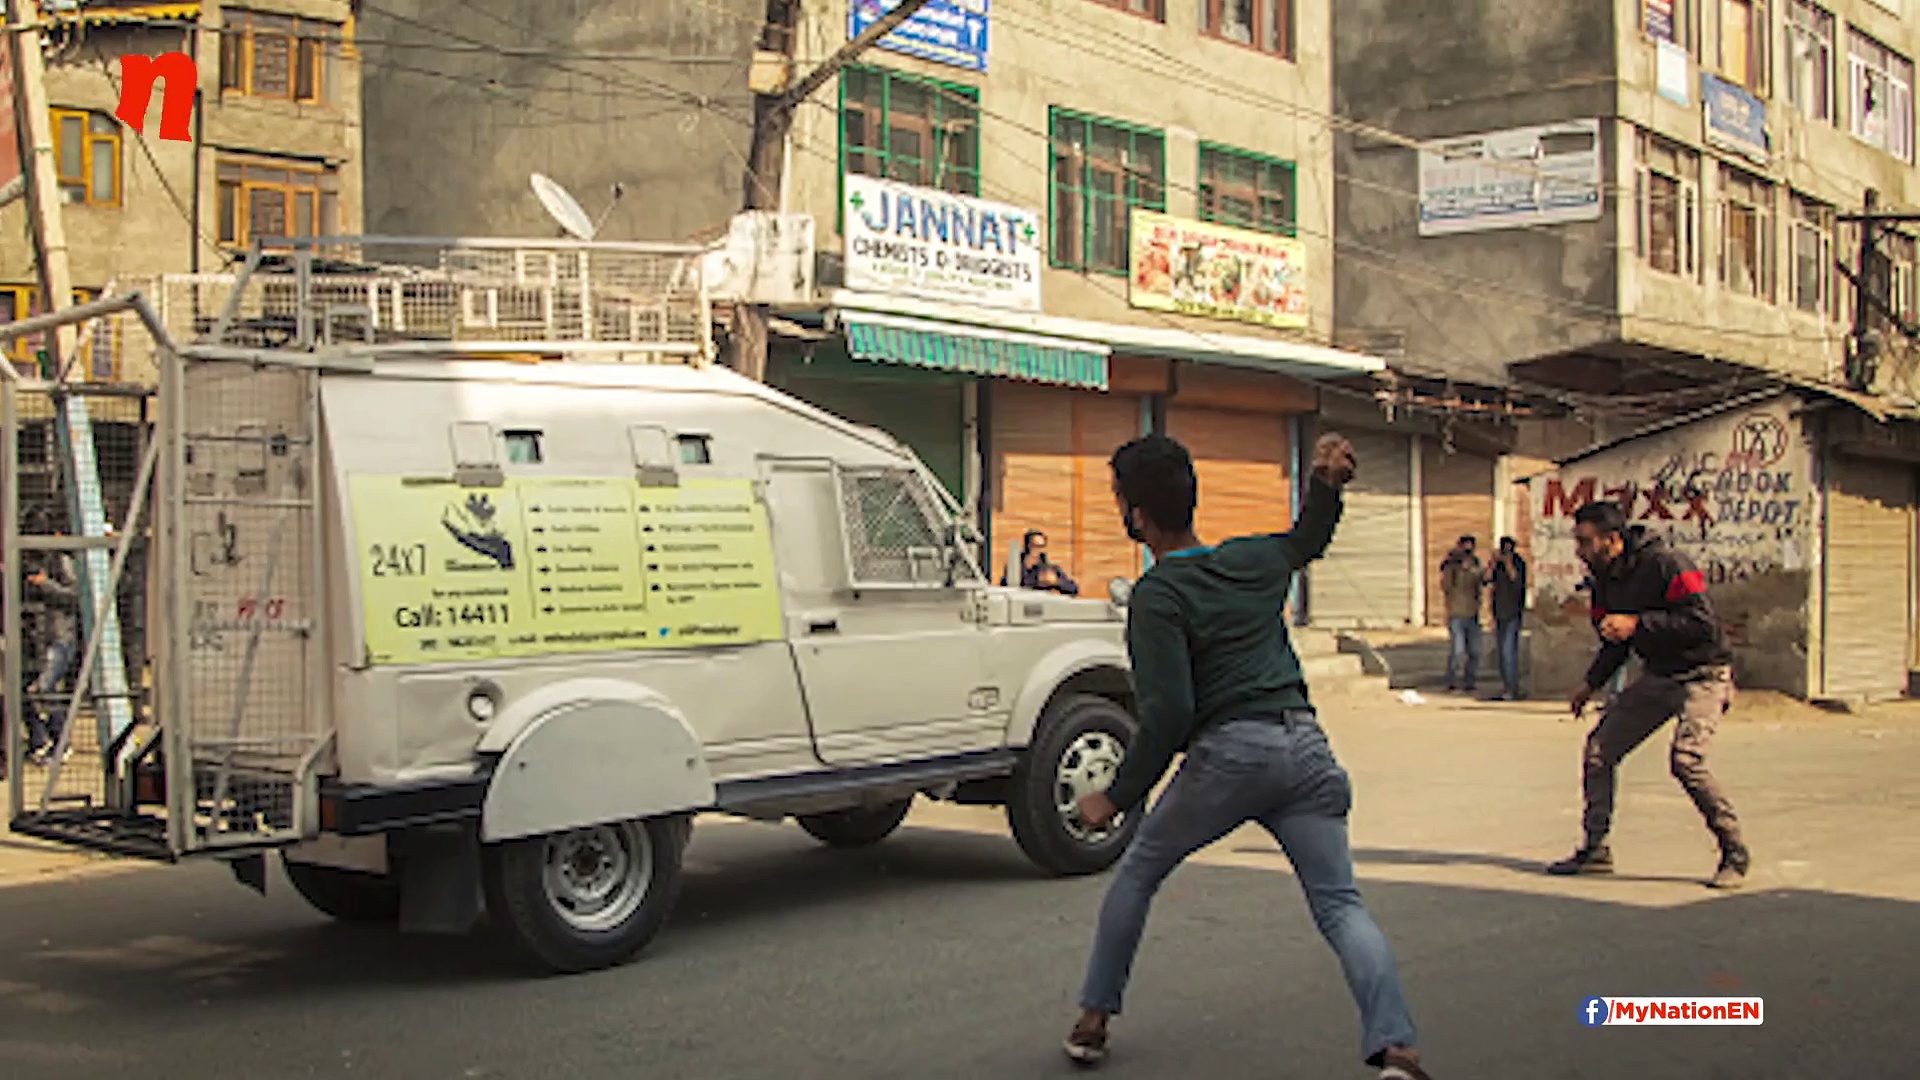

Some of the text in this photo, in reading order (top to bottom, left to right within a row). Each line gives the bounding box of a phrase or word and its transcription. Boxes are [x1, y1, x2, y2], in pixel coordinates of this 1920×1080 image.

[862, 190, 1024, 255] JANNAT
[853, 235, 928, 267] CHEMISTS
[395, 603, 509, 628] Call: 14411
